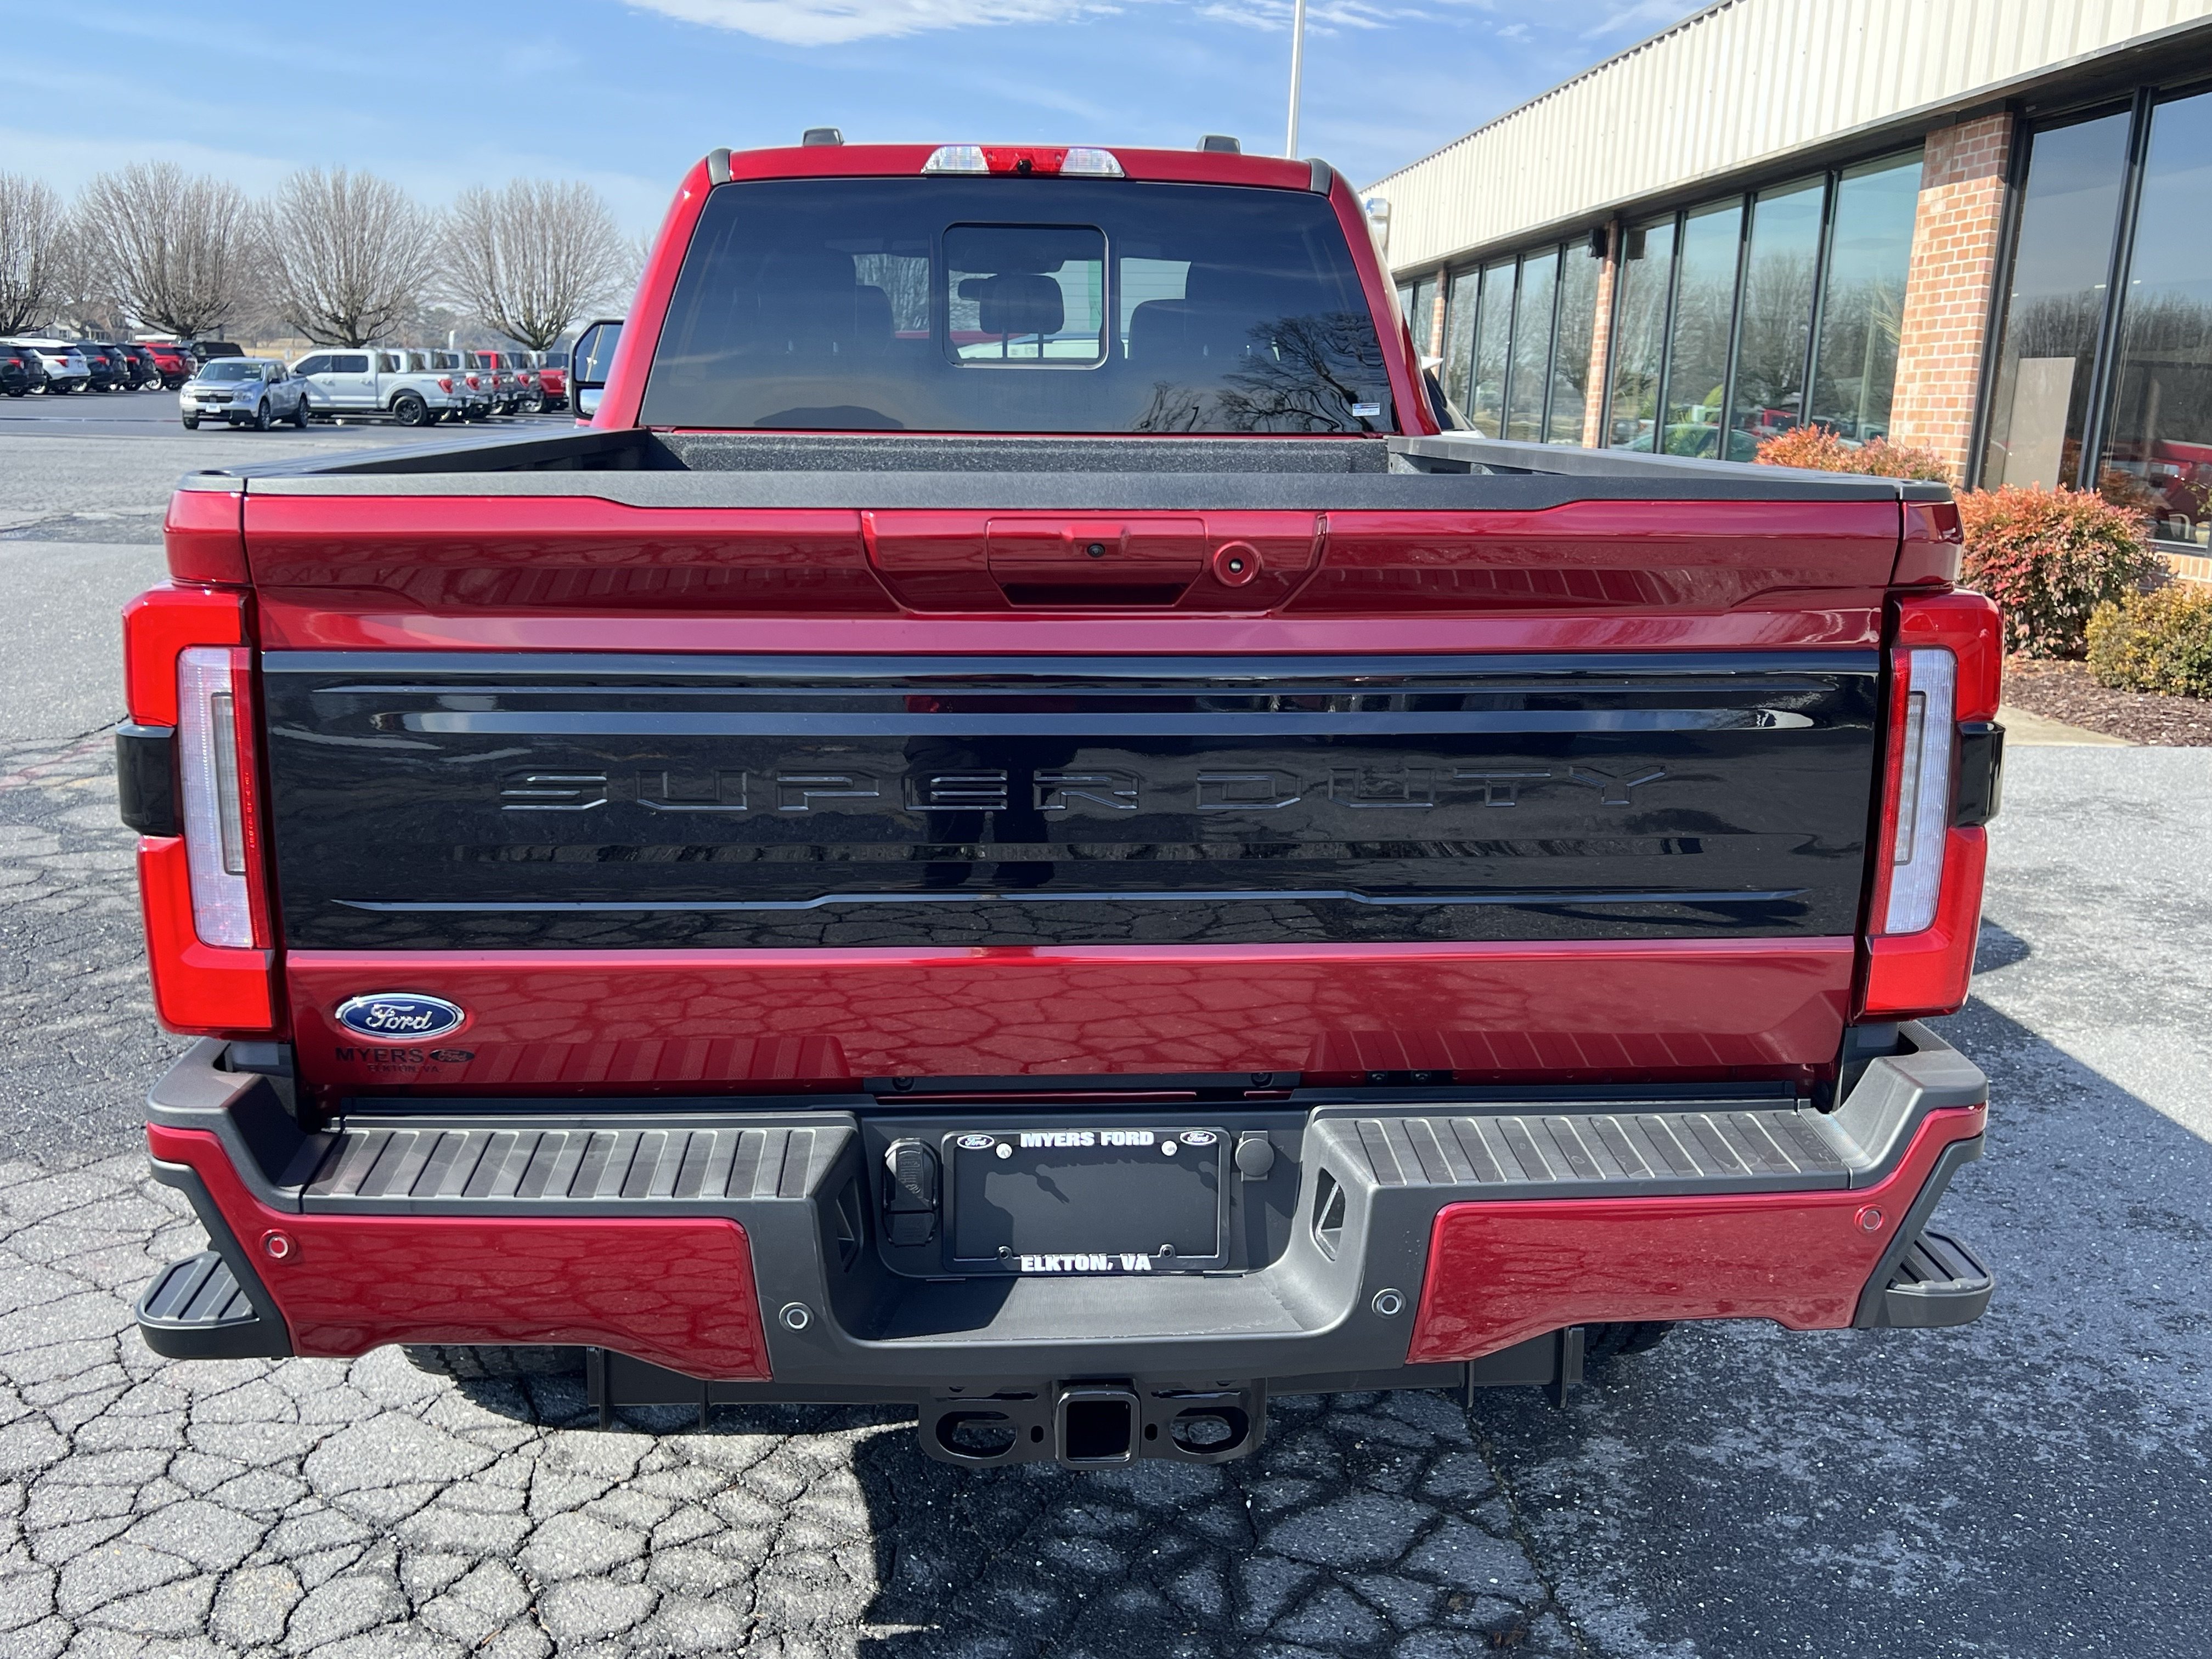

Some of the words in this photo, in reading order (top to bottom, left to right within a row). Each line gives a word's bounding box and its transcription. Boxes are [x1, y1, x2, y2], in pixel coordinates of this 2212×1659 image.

[500, 768, 1139, 810] SUPER
[1197, 765, 1667, 809] DUTY
[365, 1003, 433, 1030] Ford
[335, 1047, 424, 1063] MYERS
[964, 1136, 988, 1147] Ford
[1020, 1132, 1095, 1148] MYERS
[1101, 1131, 1154, 1146] FORD
[1187, 1132, 1209, 1143] Ford
[1020, 1254, 1114, 1272] ELKTON,
[1119, 1253, 1152, 1271] VA
